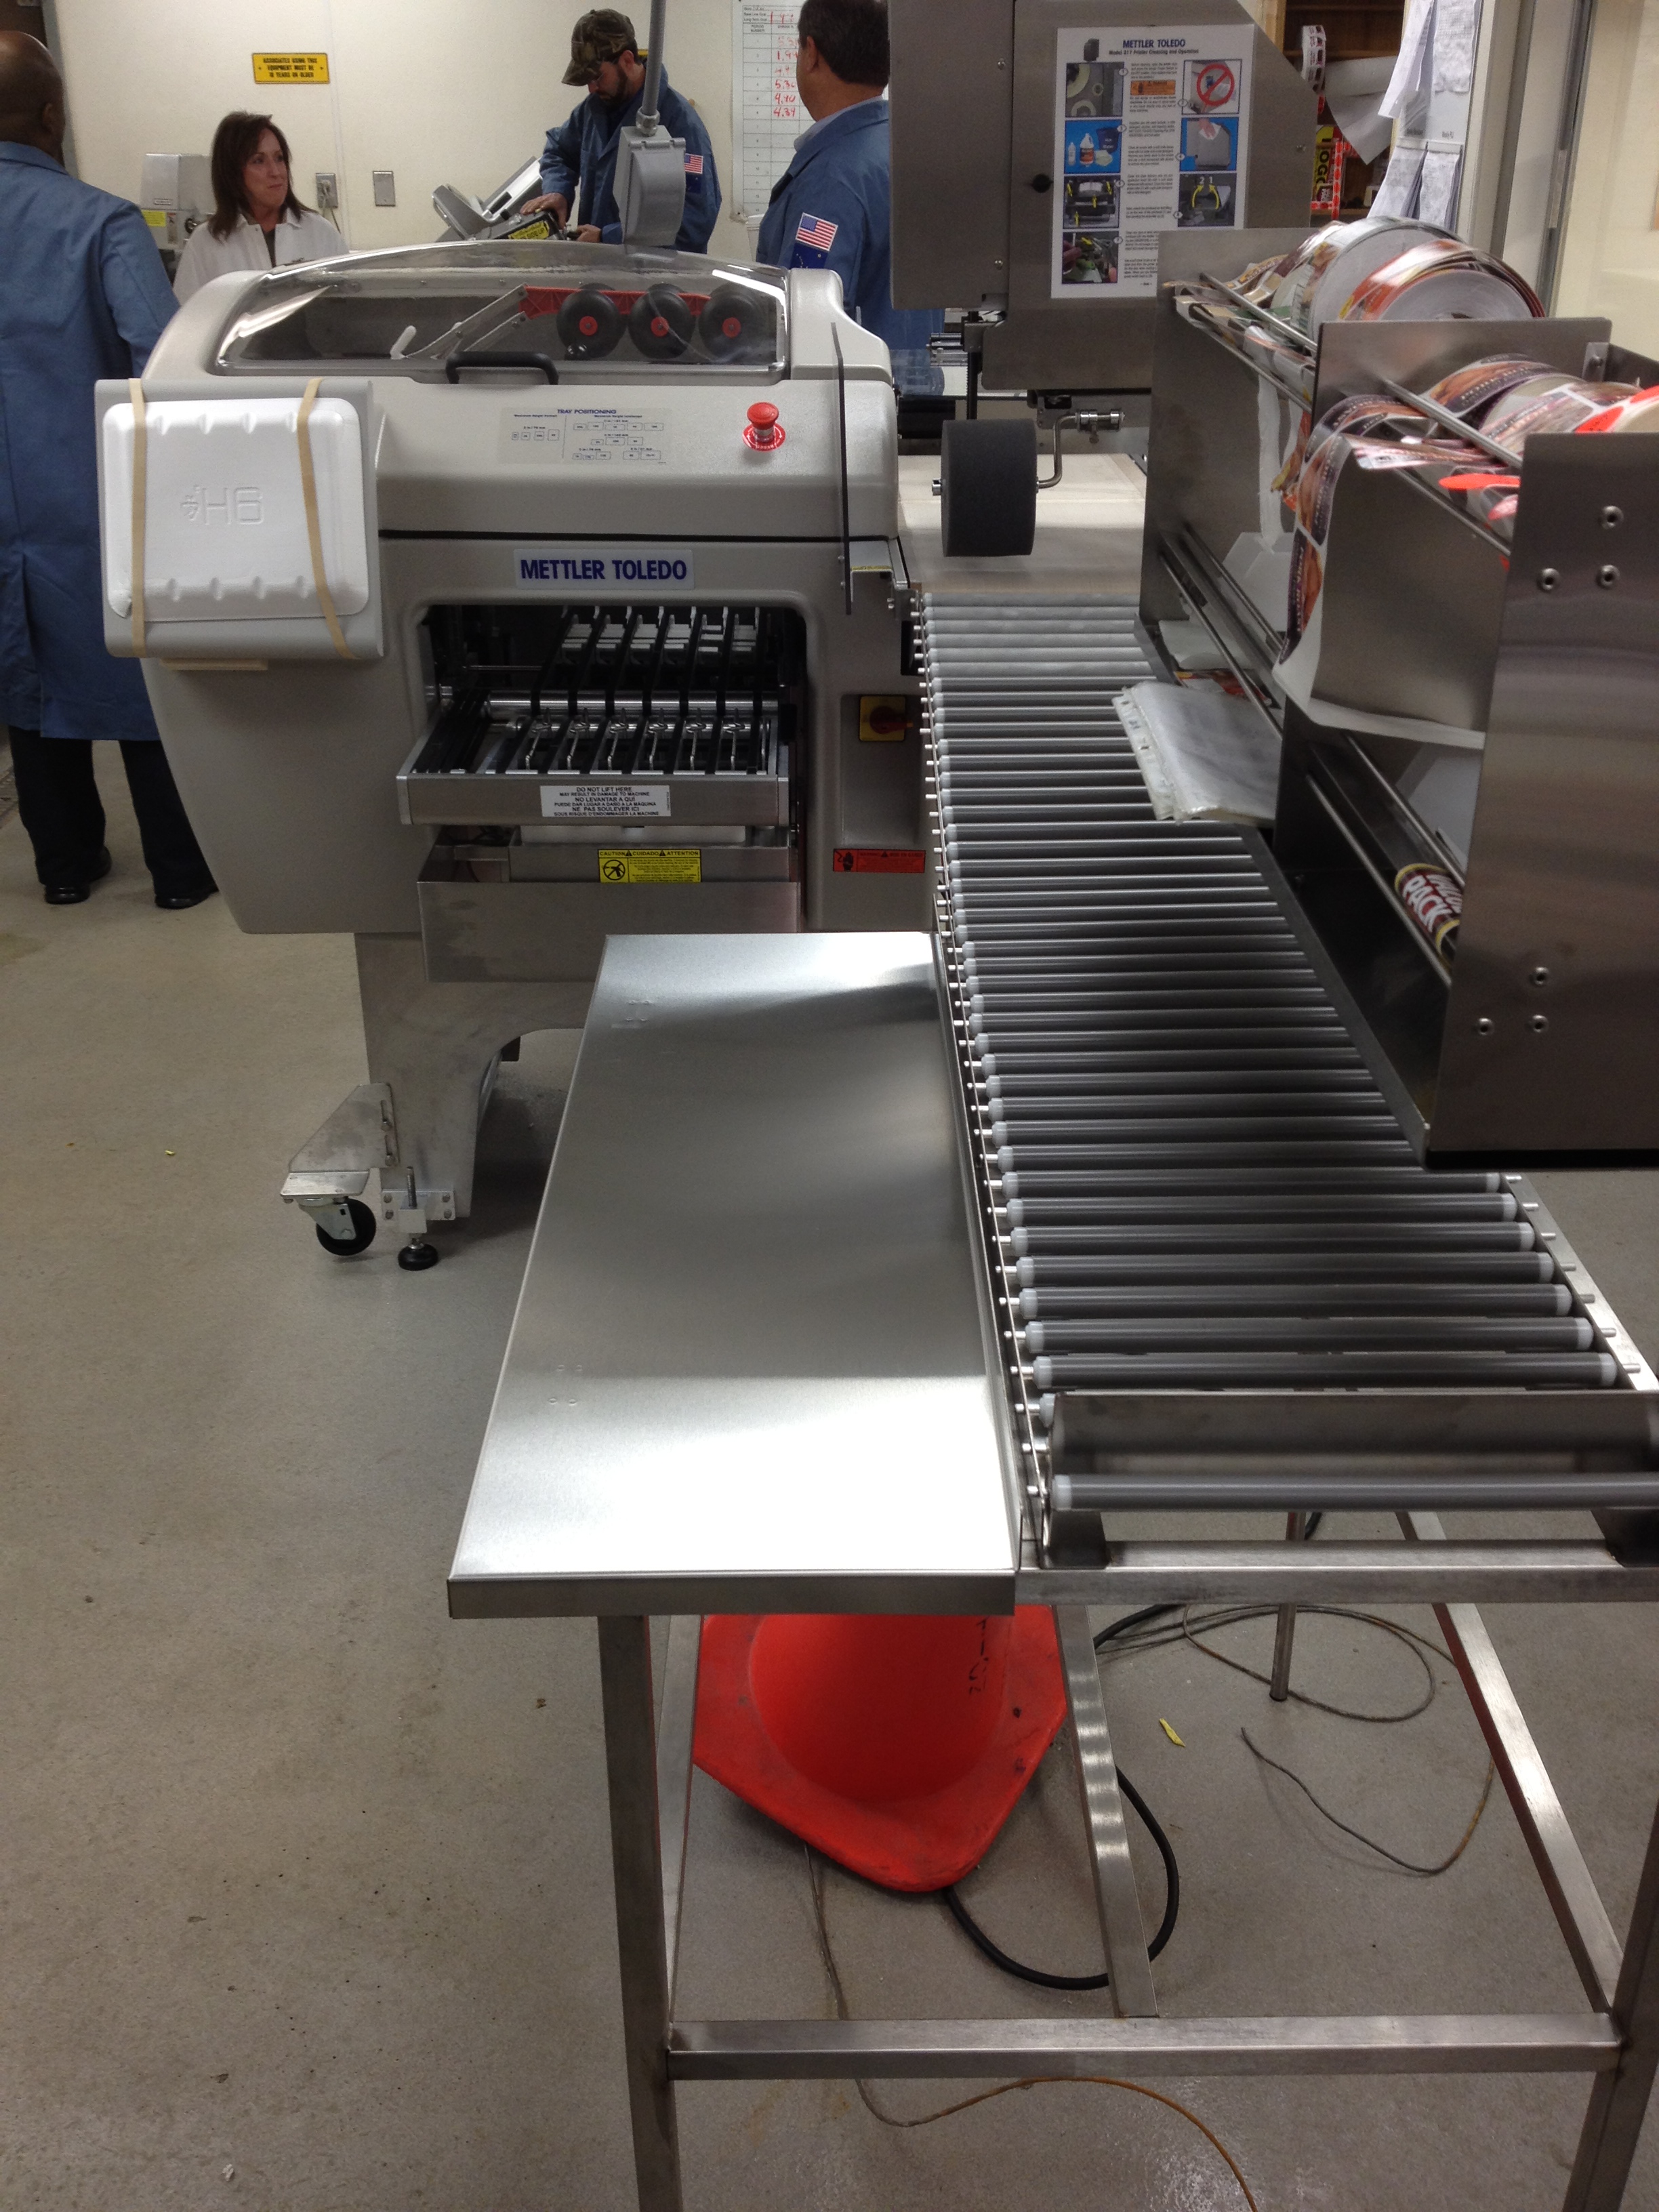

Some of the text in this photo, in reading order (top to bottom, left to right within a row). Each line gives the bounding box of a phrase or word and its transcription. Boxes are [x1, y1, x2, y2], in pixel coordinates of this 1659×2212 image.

[1122, 39, 1186, 48] METTLER TOLEDO
[520, 560, 687, 580] METTLER TOLEDO
[1403, 875, 1453, 933] PACK
